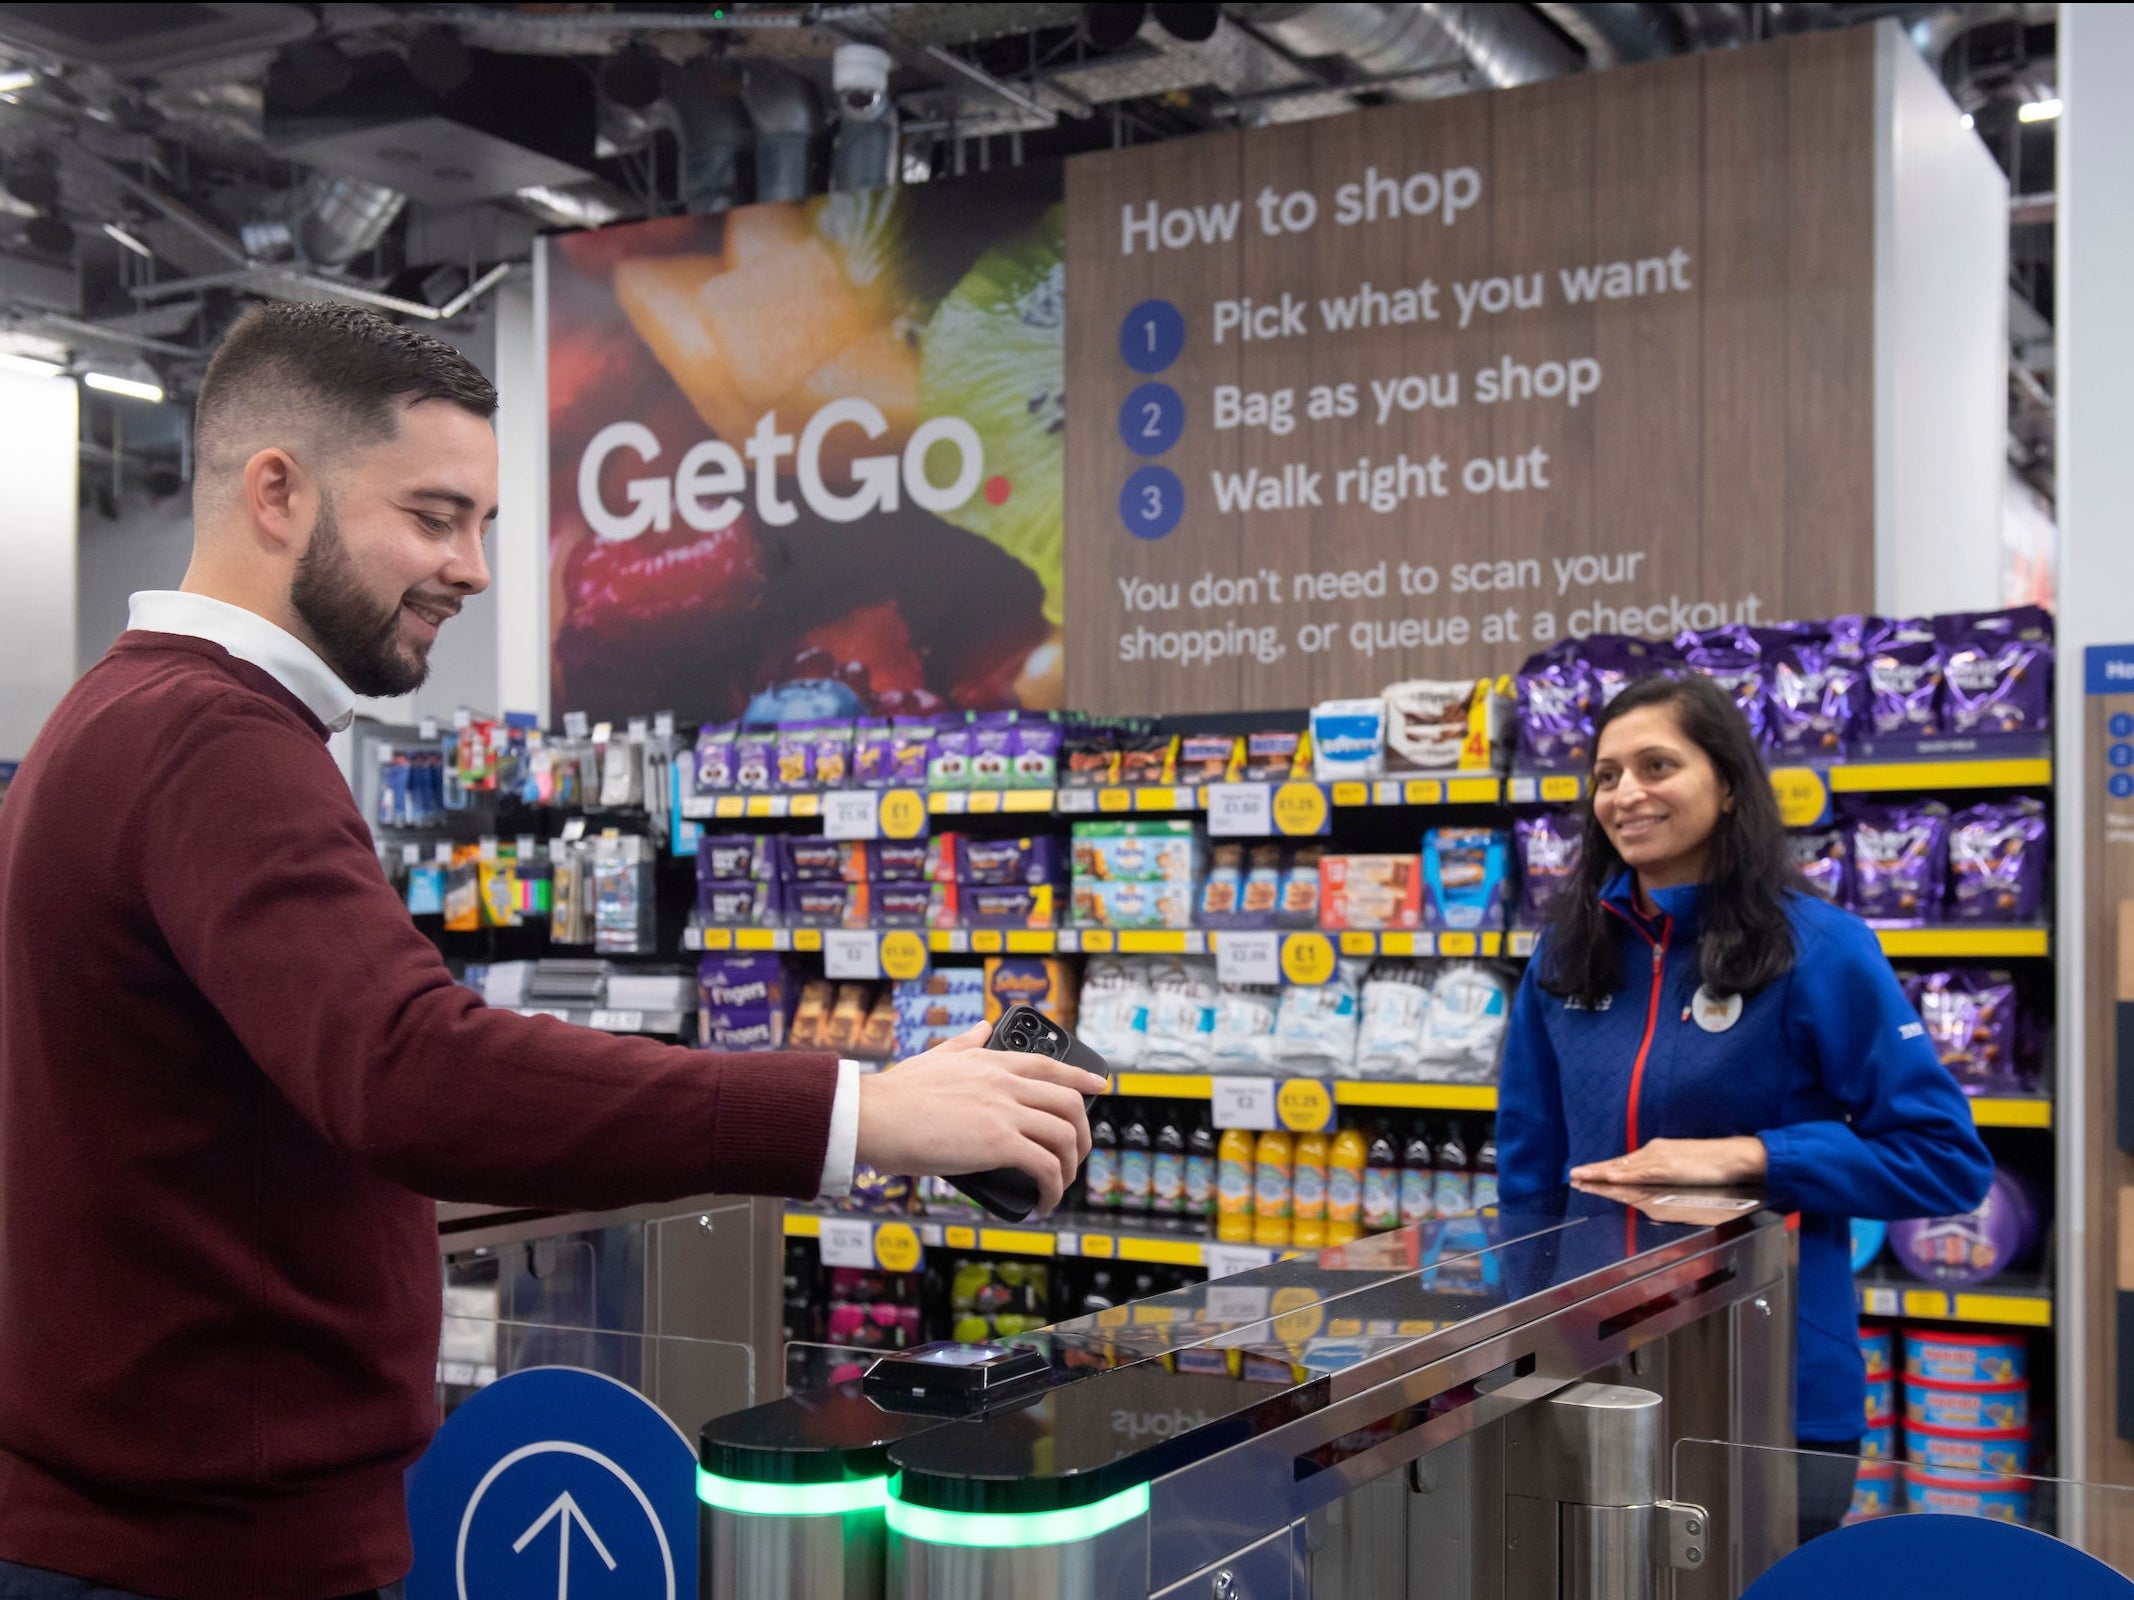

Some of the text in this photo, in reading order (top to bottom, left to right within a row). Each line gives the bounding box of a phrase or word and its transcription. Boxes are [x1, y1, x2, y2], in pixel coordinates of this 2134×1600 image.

[1121, 167, 1481, 255] How to shop
[1215, 250, 1689, 343] Pick what you want
[1143, 320, 1156, 352] 1
[1143, 403, 1160, 437] 2
[1214, 355, 1601, 435] Bag as you shop
[577, 397, 1012, 542] GetGo.
[1211, 446, 1549, 513] Walk right out
[1141, 485, 1162, 520] 3
[1118, 552, 1643, 612] You don't need to scan your
[1119, 624, 1285, 665] shopping,
[1298, 623, 1337, 653] or
[1350, 617, 1470, 656] queue
[1481, 609, 1520, 644] at
[1532, 611, 1556, 641] a
[1467, 732, 1485, 757] 4
[1294, 944, 1315, 962] £1
